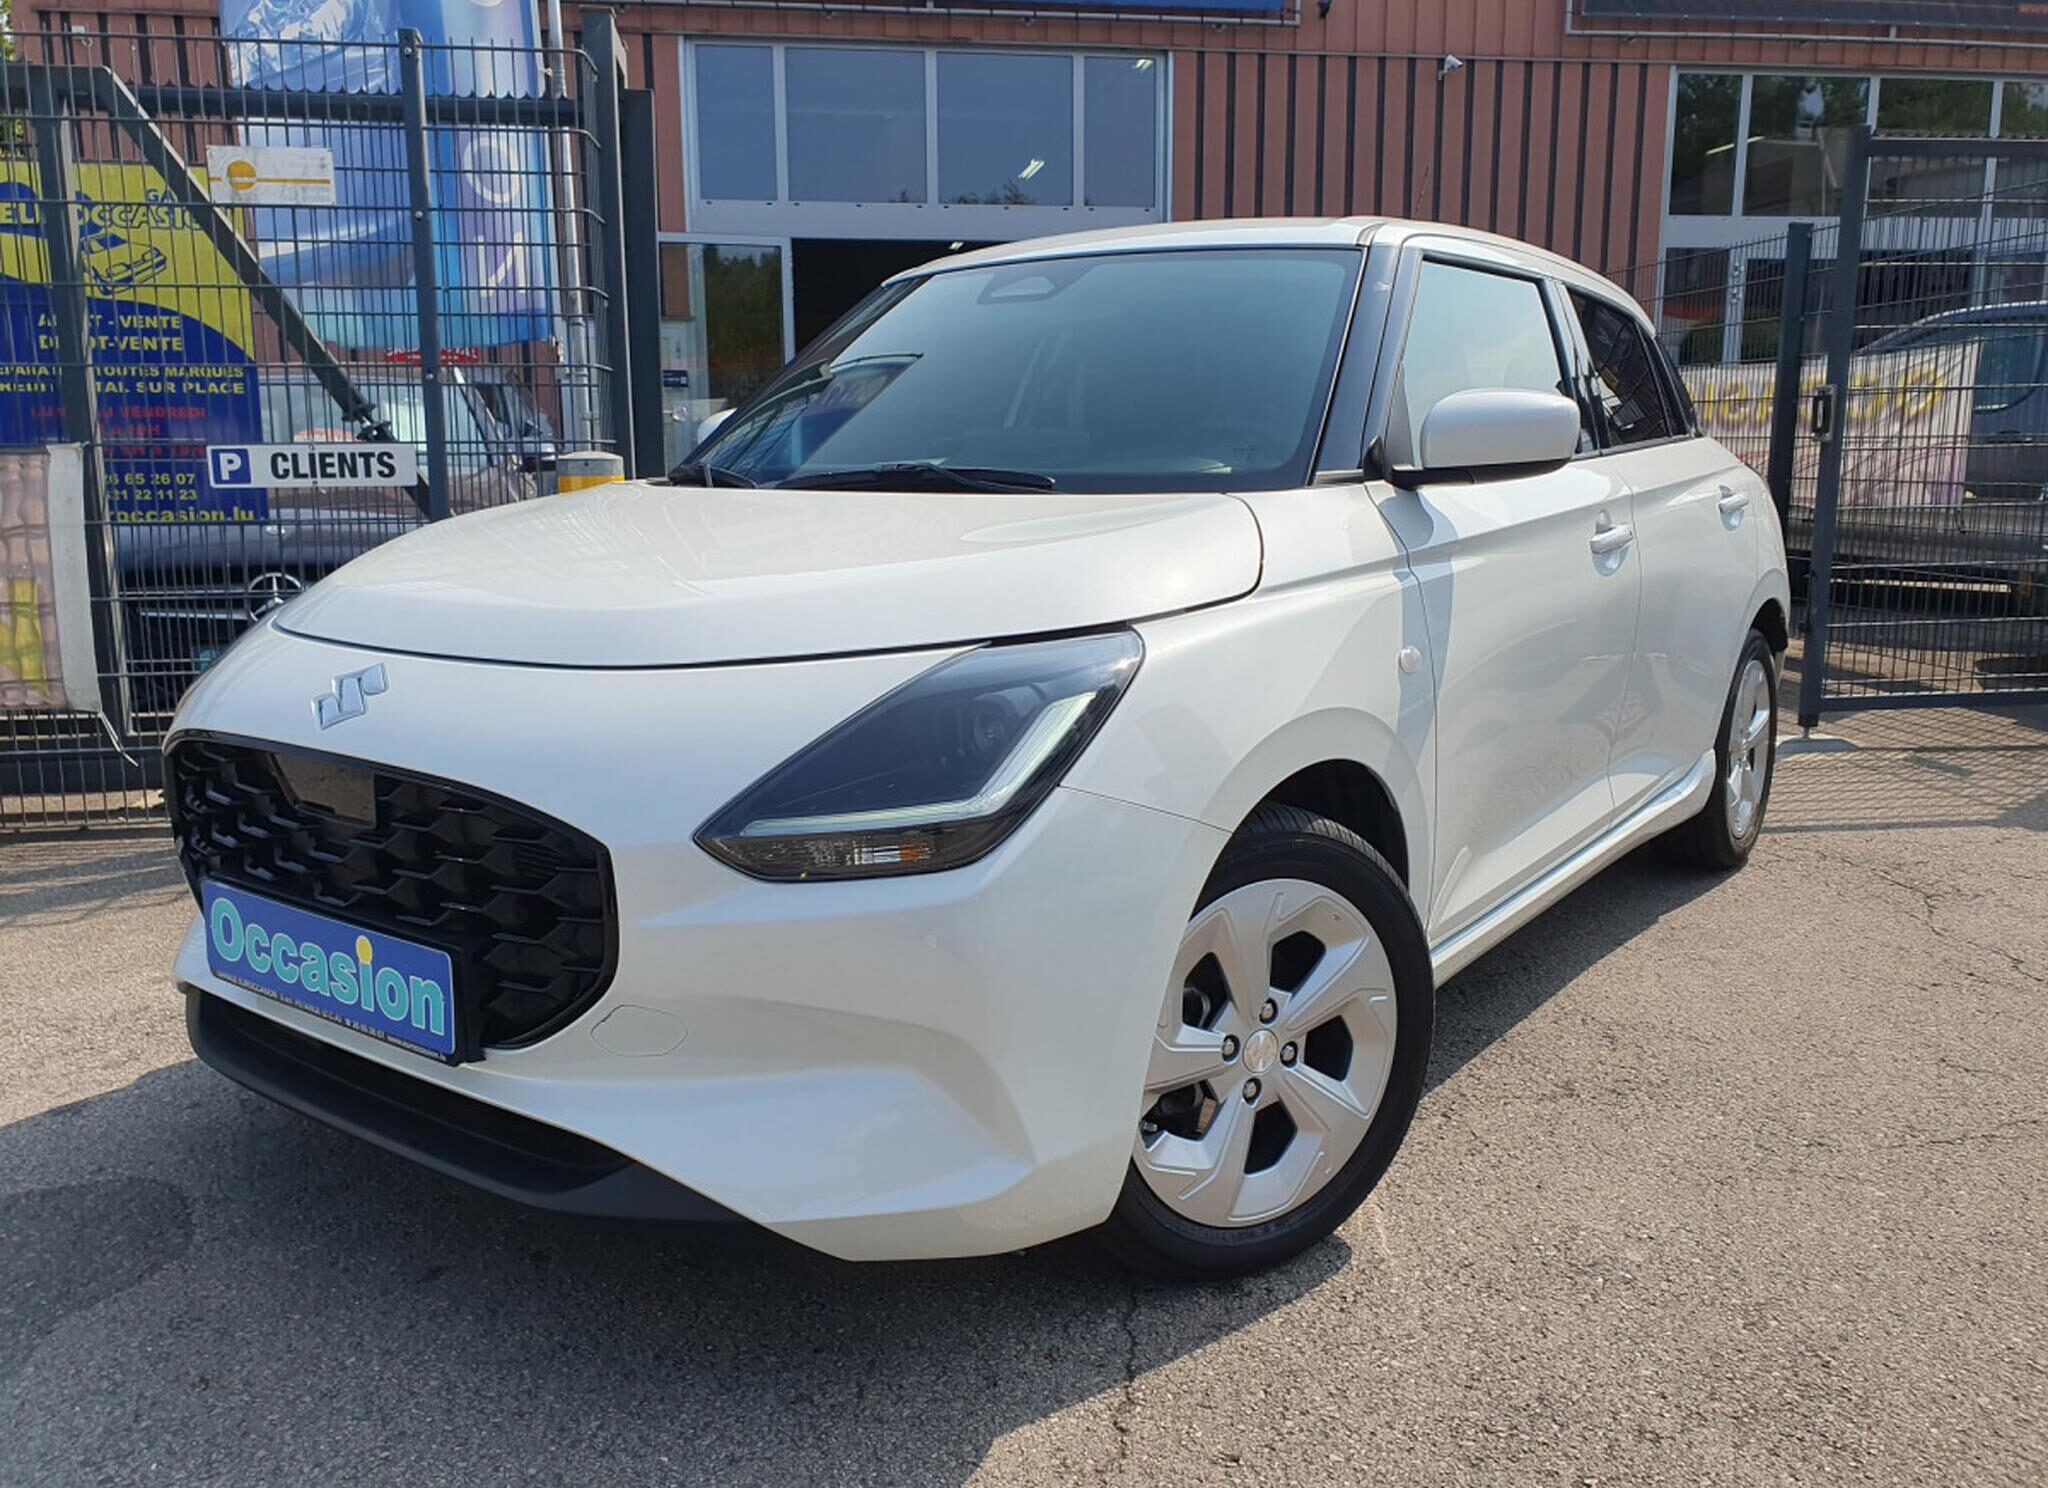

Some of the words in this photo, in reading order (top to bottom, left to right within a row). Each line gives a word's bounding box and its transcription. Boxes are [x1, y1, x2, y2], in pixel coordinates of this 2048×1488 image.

[119, 314, 182, 329] VENTE
[164, 367, 244, 378] MARQUES
[135, 382, 176, 394] SUR
[183, 383, 244, 395] PLACE
[219, 453, 242, 481] P
[270, 452, 397, 480] CLIENTS
[124, 472, 146, 486] 65
[175, 473, 196, 486] 07
[211, 897, 445, 1036] Occasion
